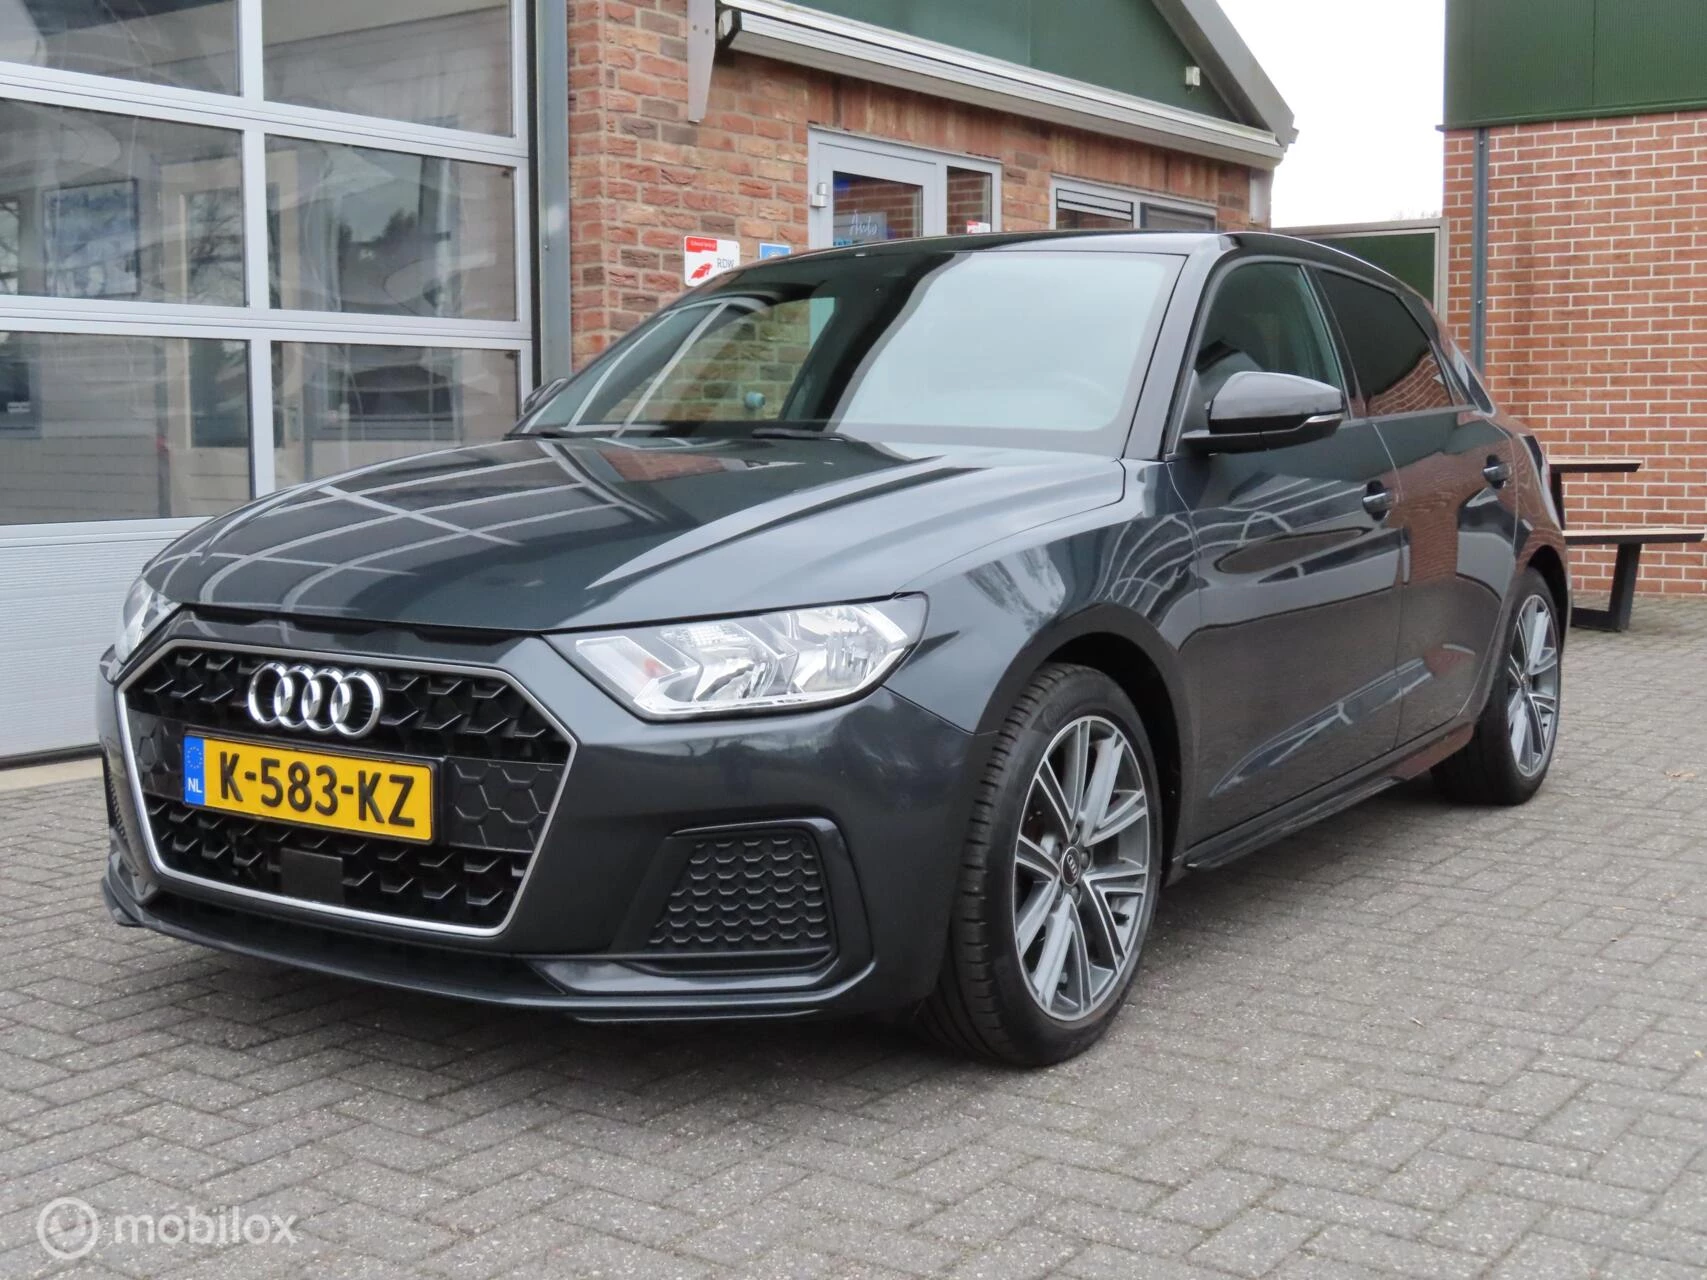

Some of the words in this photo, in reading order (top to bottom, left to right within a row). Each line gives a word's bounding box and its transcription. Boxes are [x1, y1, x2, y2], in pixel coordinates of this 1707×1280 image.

[717, 258, 735, 269] RDW
[187, 777, 203, 794] NL
[219, 751, 416, 828] K-583-KZ
